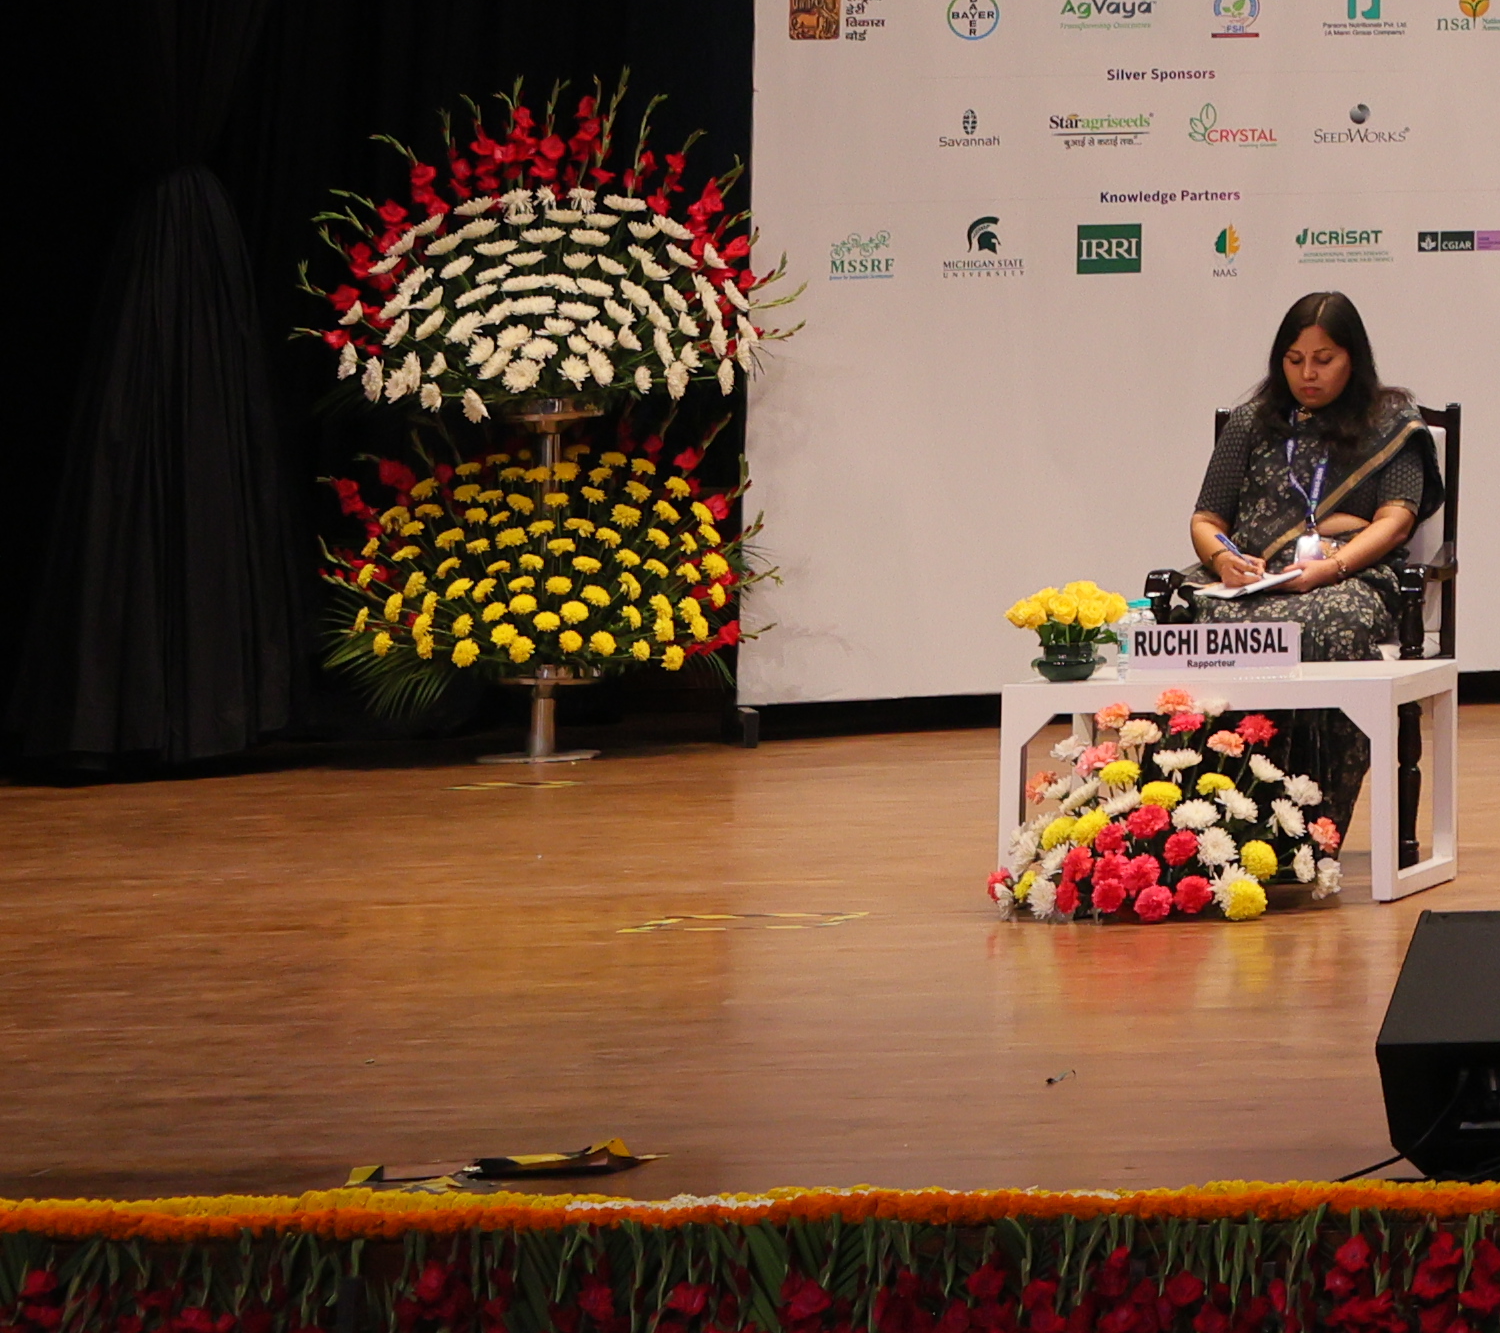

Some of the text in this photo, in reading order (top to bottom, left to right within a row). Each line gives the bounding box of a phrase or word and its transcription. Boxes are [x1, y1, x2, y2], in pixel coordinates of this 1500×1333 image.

[952, 11, 995, 20] BAYER
[1106, 68, 1216, 83] Silver Sponsors
[938, 135, 1001, 148] Savannah
[1208, 128, 1277, 143] CRYSTAL
[1100, 189, 1241, 205] Knowledge Partners
[1311, 229, 1383, 246] ICRISAT
[1080, 237, 1139, 260] IRRI
[1442, 240, 1472, 250] CGIAR
[831, 258, 895, 273] MSSRF
[943, 258, 1024, 269] MICHIGAN STATE
[943, 270, 1024, 278] UNIVERSITY
[1212, 268, 1238, 278] NAAS
[1134, 627, 1288, 657] RUCHI BANSAL
[1187, 659, 1235, 669] Rapporteur
